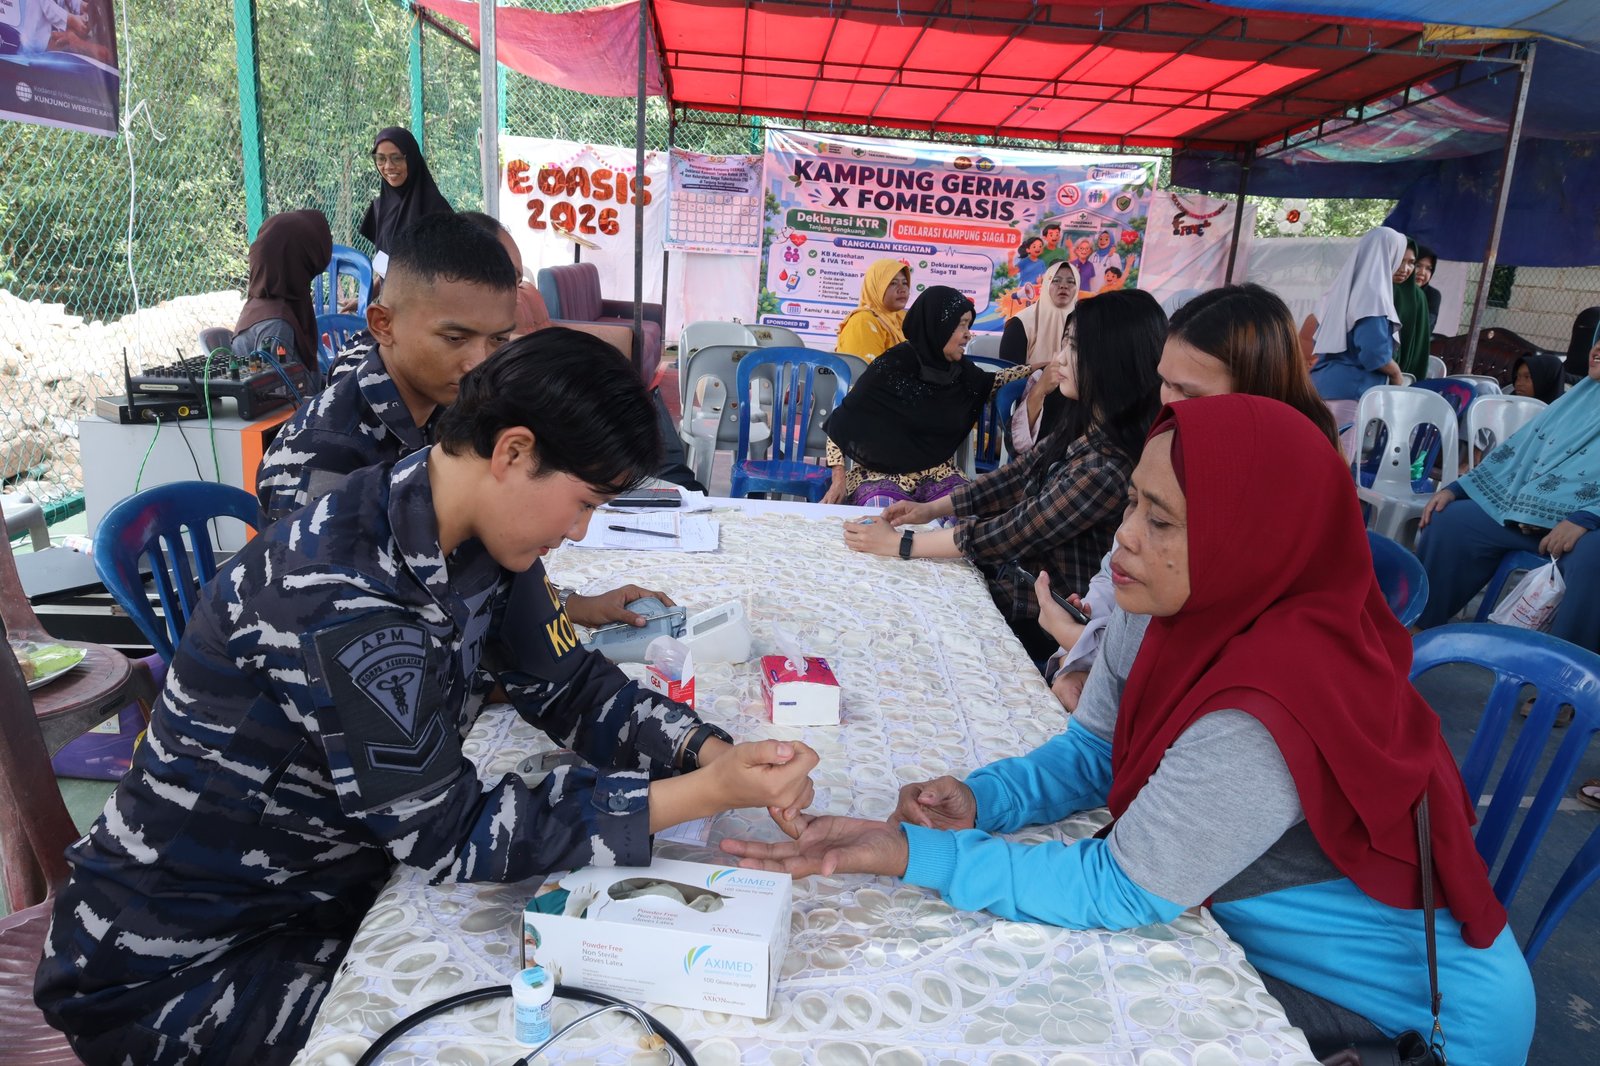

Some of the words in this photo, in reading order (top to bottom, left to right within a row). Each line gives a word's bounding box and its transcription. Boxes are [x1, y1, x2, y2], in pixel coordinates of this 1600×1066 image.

[34, 95, 70, 109] KUNJUNGI
[72, 104, 98, 116] WEBSITE
[794, 159, 934, 192] KAMPUNG
[941, 171, 1046, 201] GERMAS
[828, 187, 849, 208] X
[857, 189, 1015, 221] FOMEOASIS
[527, 199, 619, 236] 2026
[797, 212, 853, 227] Deklarasi
[855, 217, 880, 229] KTR
[808, 224, 832, 234] Tanjung
[832, 225, 866, 236] Sengkuang
[898, 224, 941, 238] DEKLARASI
[942, 227, 980, 242] KAMPUNG
[982, 230, 1005, 243] SIAGA
[1006, 233, 1017, 243] TB
[842, 240, 891, 251] RANGKAIAN
[892, 243, 931, 254] KEGIATAN
[832, 252, 865, 260] Kesehatan
[820, 269, 859, 278] Pemeriksaan
[960, 264, 988, 272] Kampung
[361, 629, 404, 653] APM
[361, 666, 383, 684] KORPS
[386, 657, 422, 669] KESEHATAN
[727, 876, 776, 887] AXIMED
[637, 908, 662, 916] Powder
[582, 940, 607, 950] Powder
[609, 944, 624, 952] Free
[582, 955, 604, 964] Gloves
[605, 959, 624, 967] Latex
[597, 951, 618, 959] Sterile
[704, 957, 753, 973] AXIMED
